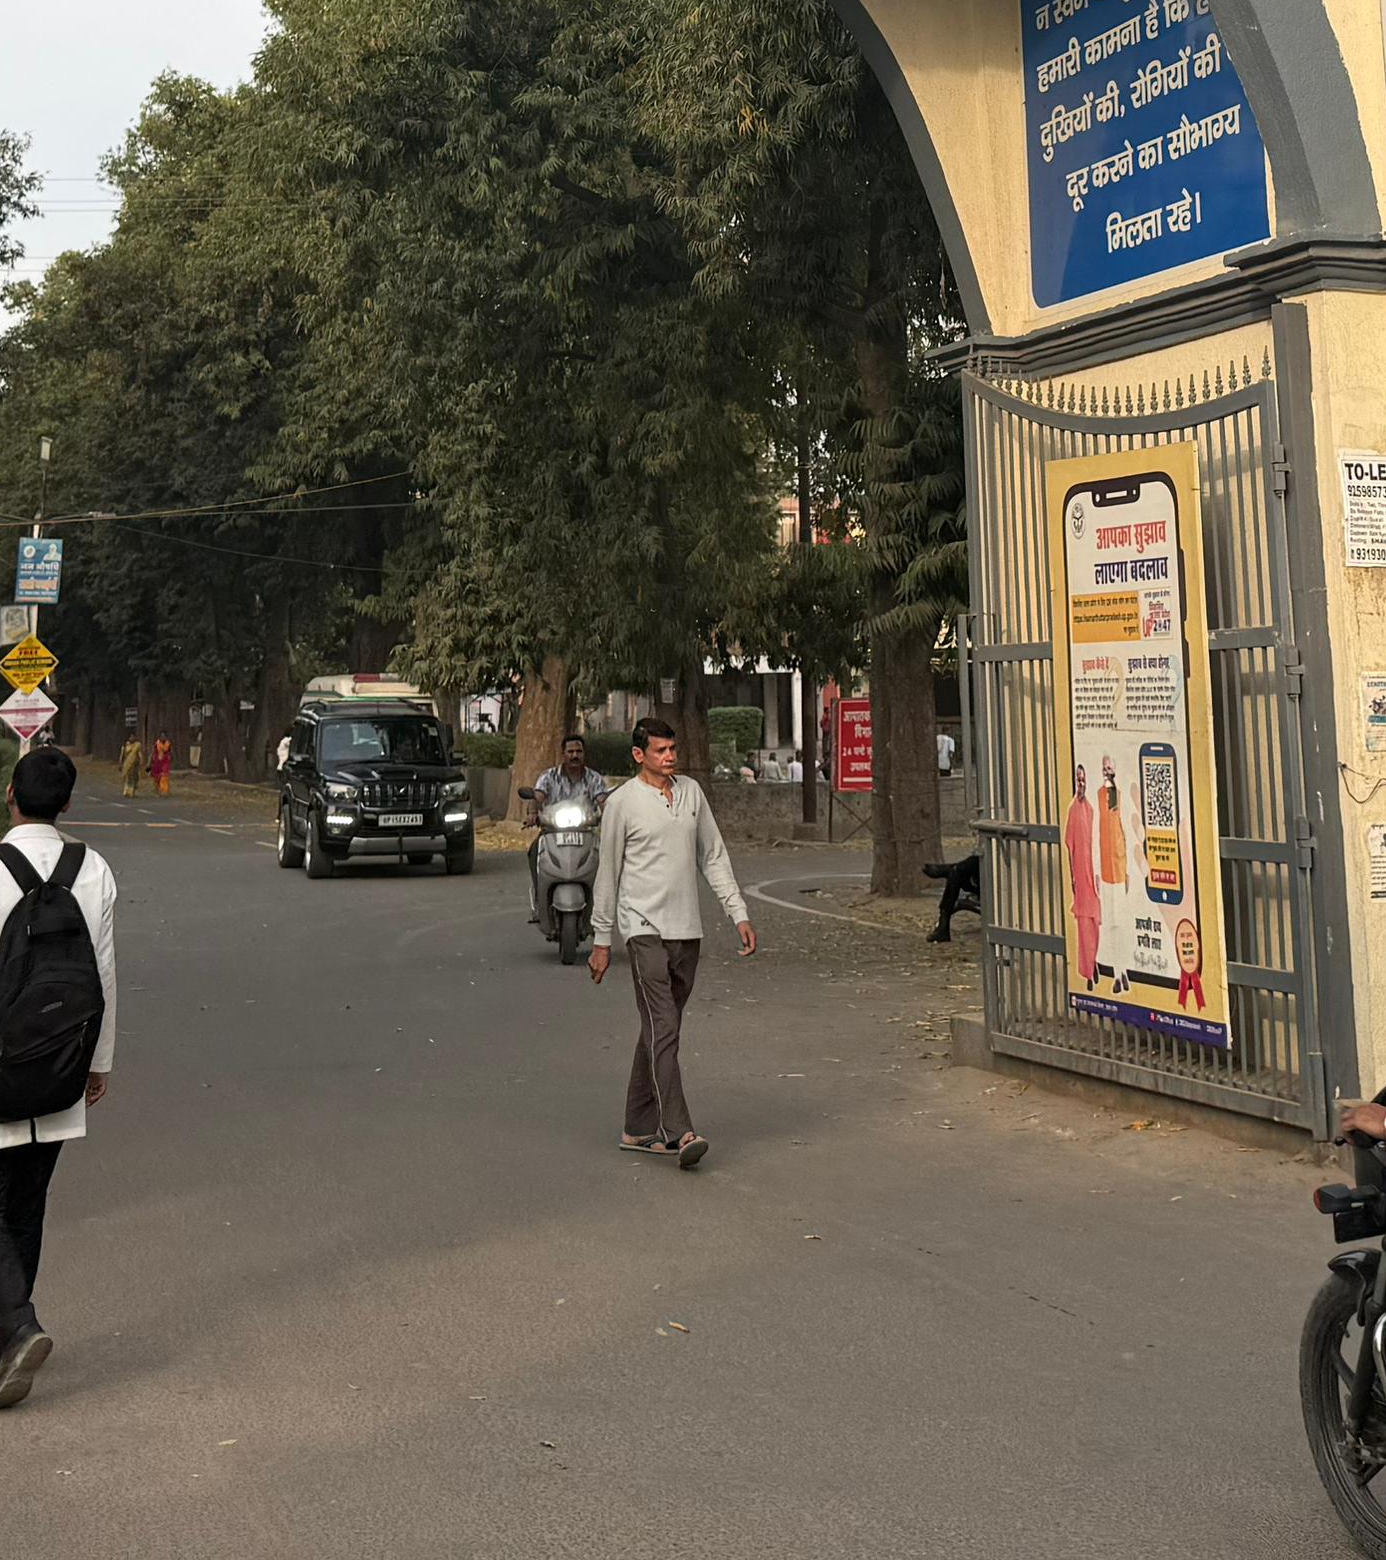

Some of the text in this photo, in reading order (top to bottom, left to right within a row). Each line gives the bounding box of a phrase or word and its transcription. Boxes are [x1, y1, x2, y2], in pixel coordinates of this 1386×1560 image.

[1035, 4, 1049, 30] न
[1037, 37, 1081, 93] हमारी
[1084, 15, 1141, 65] कामना
[1040, 33, 1221, 162] दुखियों की, रोगियों की
[1066, 104, 1241, 212] दूर करने का सौभाग्य
[1105, 208, 1162, 253] मिलता
[1096, 520, 1167, 553] आपका सुझाव
[1094, 556, 1168, 585] लाएगा बदलाव
